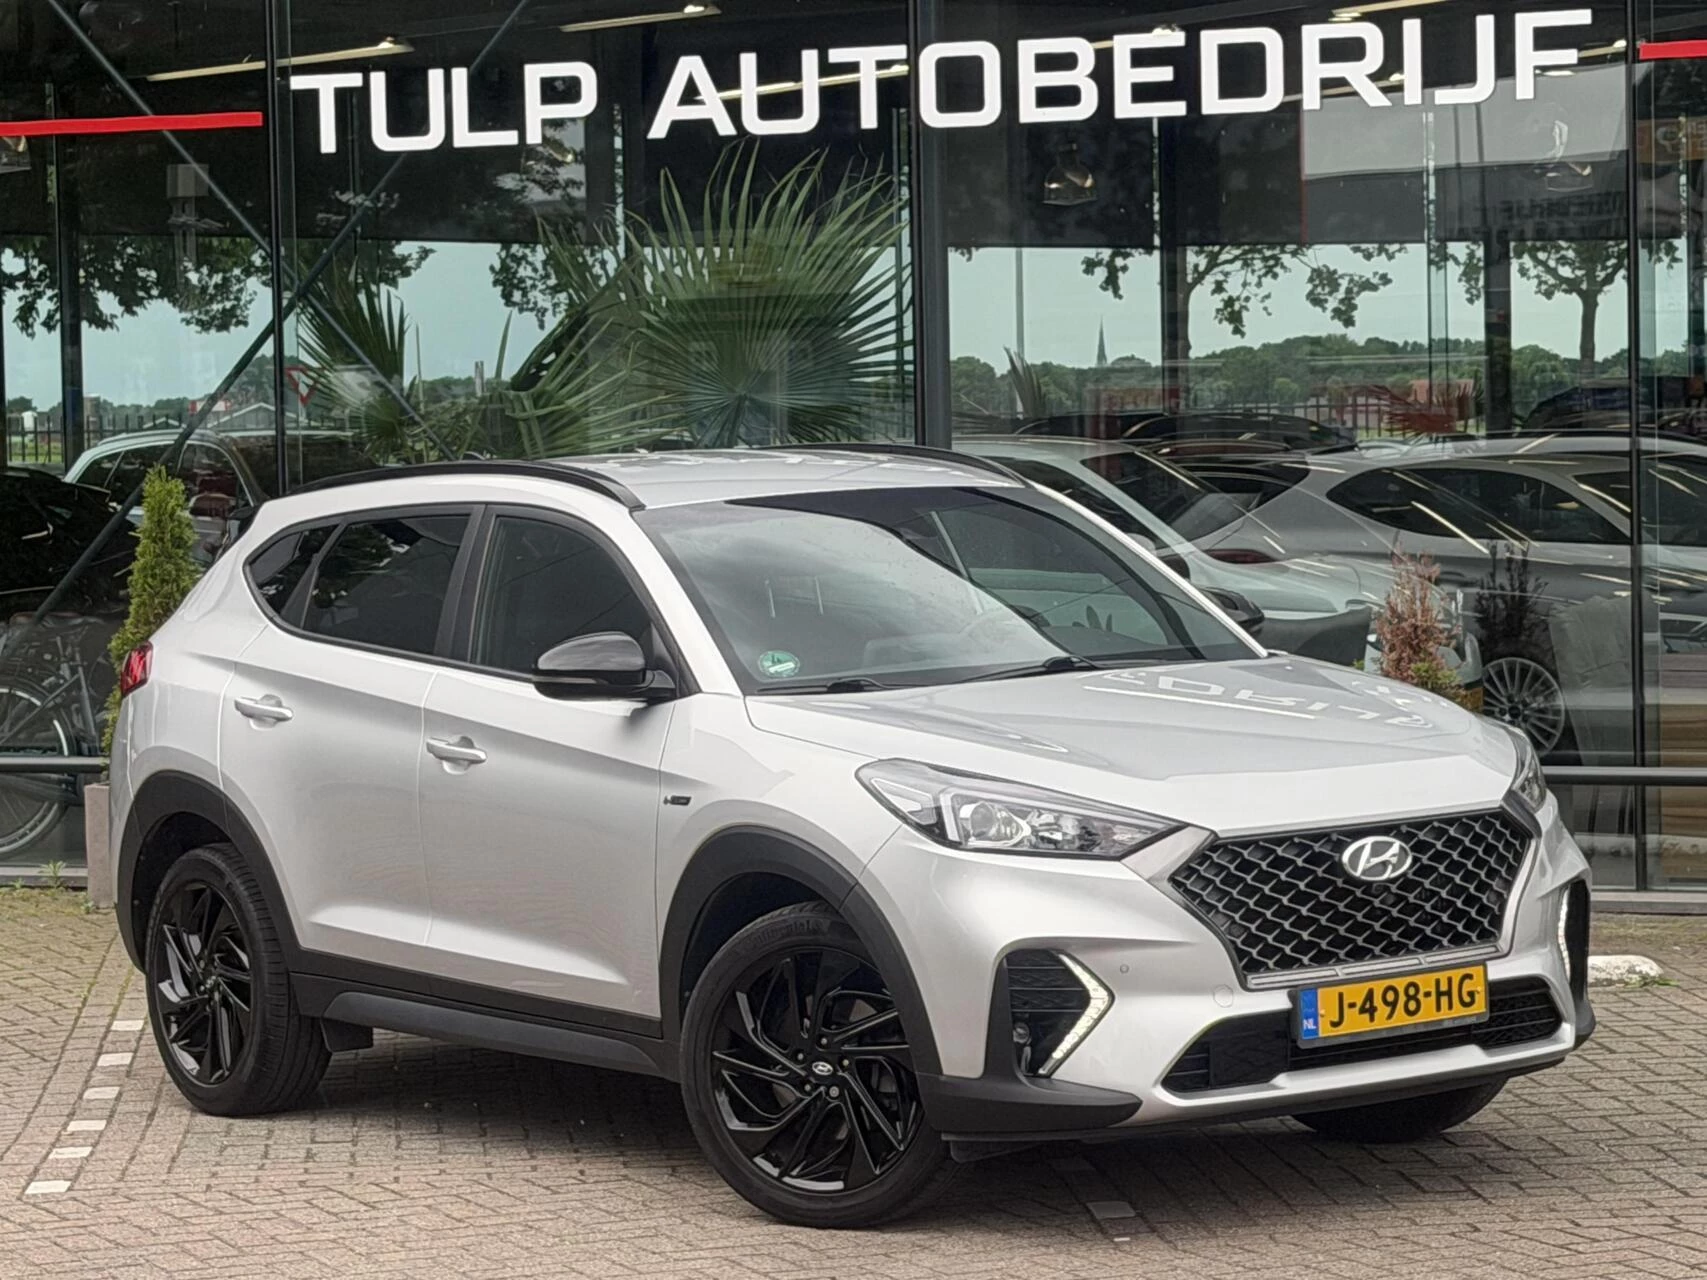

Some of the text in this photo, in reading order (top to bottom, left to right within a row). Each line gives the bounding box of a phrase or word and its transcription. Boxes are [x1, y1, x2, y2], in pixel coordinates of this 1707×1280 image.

[289, 9, 1593, 154] TULP AUTOBEDRIJF
[1303, 1018, 1316, 1029] NL
[1329, 973, 1476, 1028] J-498-HG
